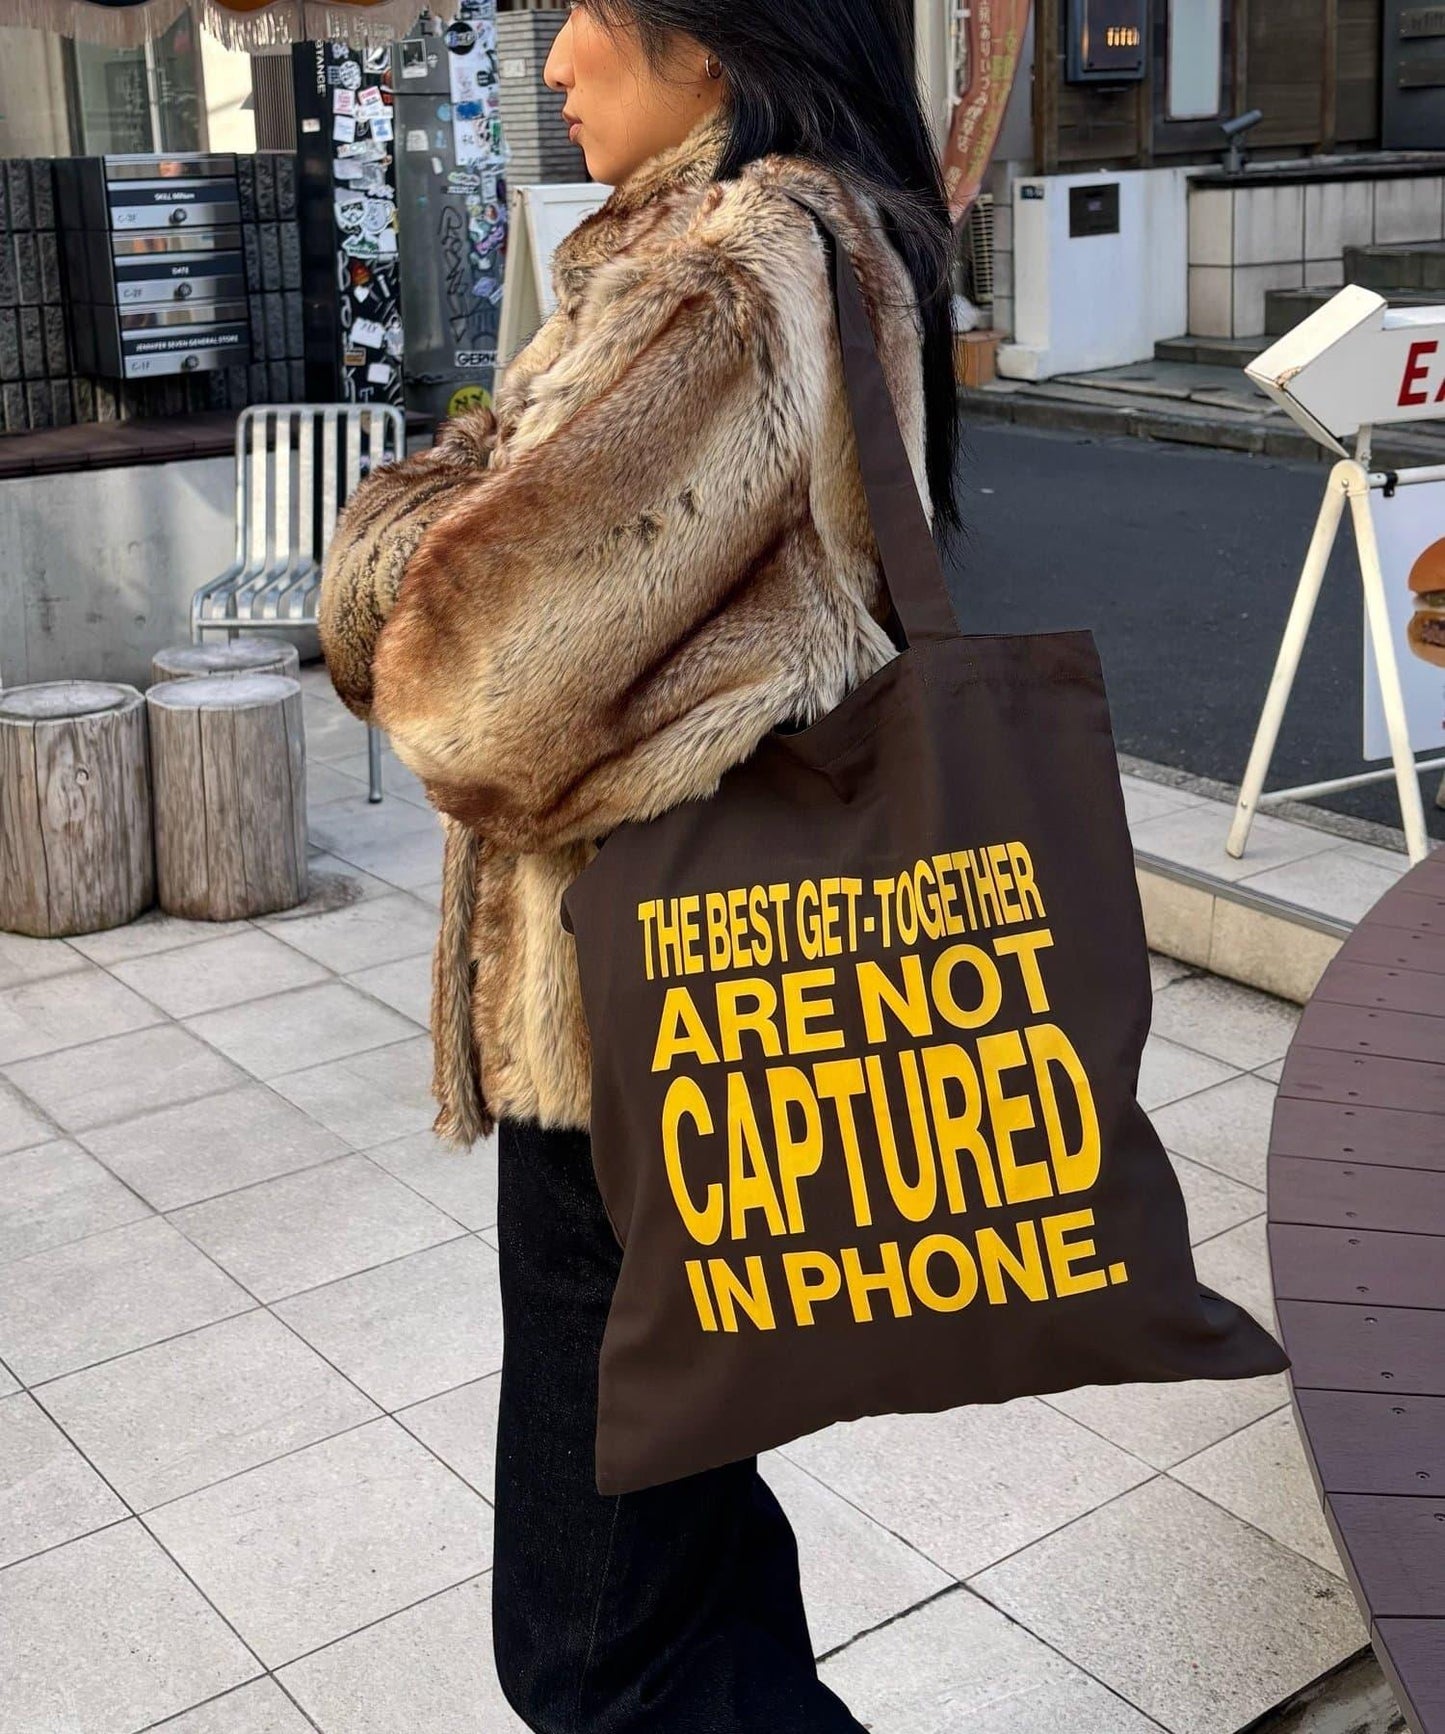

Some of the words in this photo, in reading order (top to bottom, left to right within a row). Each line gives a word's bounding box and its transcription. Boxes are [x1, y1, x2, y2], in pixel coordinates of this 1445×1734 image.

[1397, 340, 1445, 406] E
[637, 894, 705, 980] THE
[705, 883, 789, 972] BEST
[796, 843, 1045, 961] GET-TOGETHER
[651, 967, 845, 1072] ARE
[855, 928, 1054, 1045] NOT
[661, 1023, 1101, 1246] CAPTURED
[685, 1255, 777, 1333] IN
[781, 1207, 1129, 1327] PHONE.
